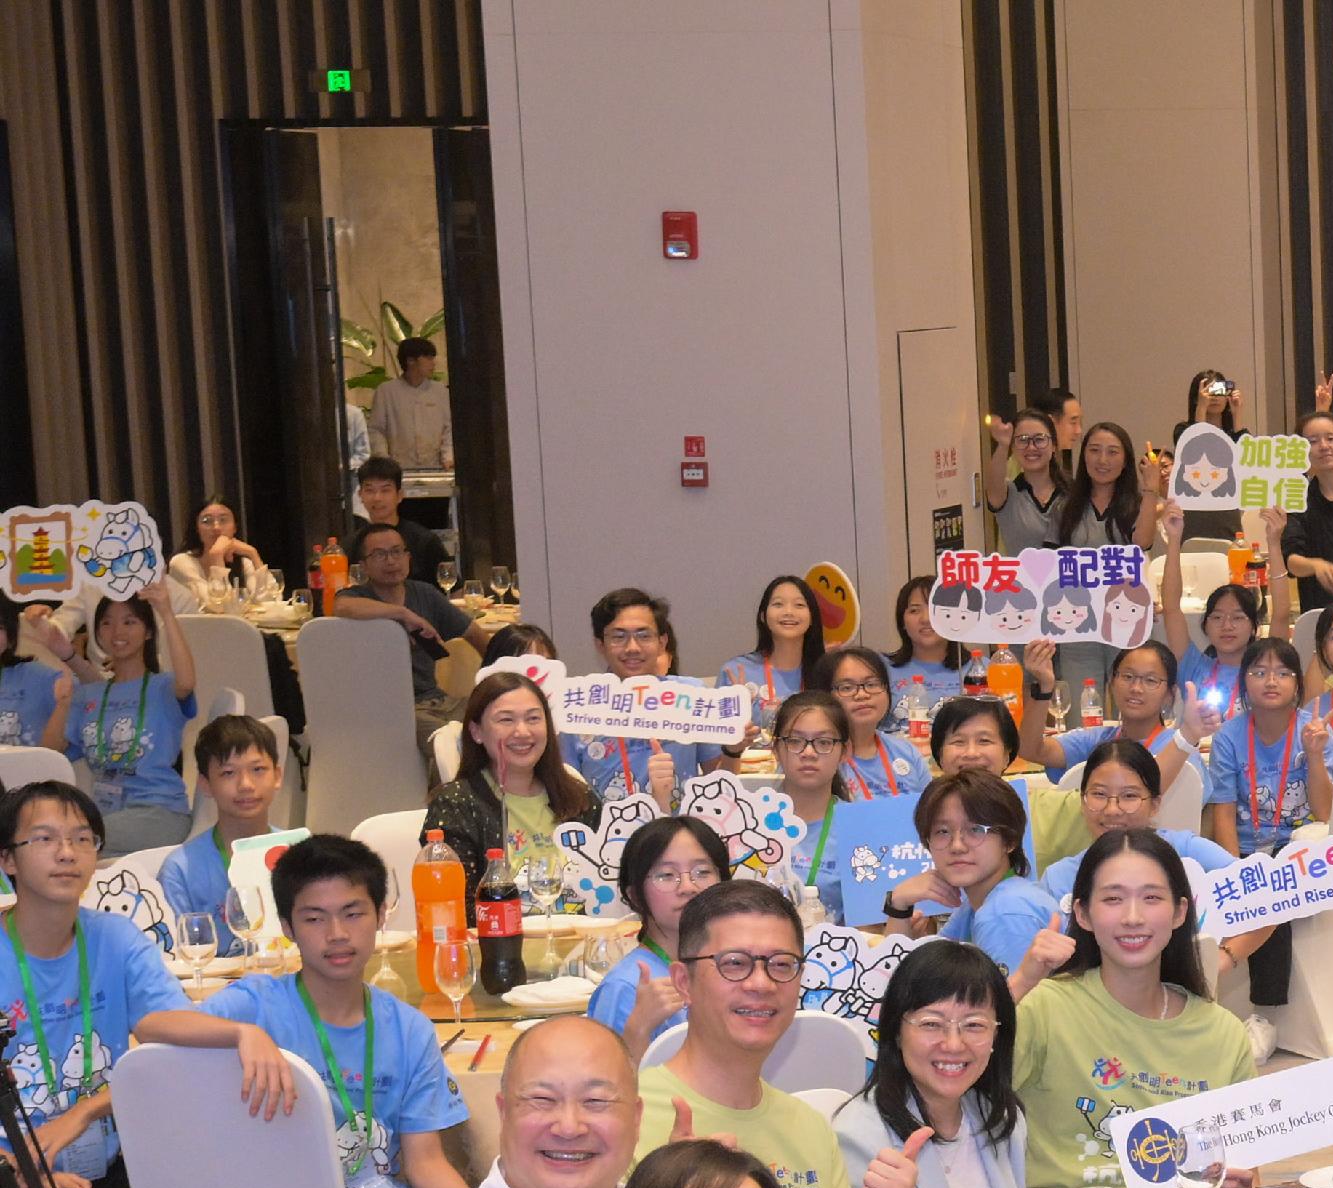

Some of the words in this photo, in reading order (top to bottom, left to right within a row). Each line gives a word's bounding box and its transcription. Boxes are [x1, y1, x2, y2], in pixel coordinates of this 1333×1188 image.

[1241, 436, 1307, 469] 加強
[1240, 476, 1306, 510] 自信
[941, 552, 1022, 593] 師友
[1058, 547, 1144, 588] 配對
[563, 683, 741, 720] 共創明Teen計劃
[566, 712, 602, 725] Strive
[605, 717, 629, 727] and
[633, 717, 658, 729] Rise
[662, 720, 736, 735] Programme
[1224, 904, 1268, 925] Strive
[1272, 893, 1300, 913] and
[1196, 1098, 1282, 1133] 香港賽馬會
[1222, 1130, 1254, 1148] Hong
[1257, 1121, 1288, 1141] Kong
[1288, 1108, 1326, 1135] Jockey
